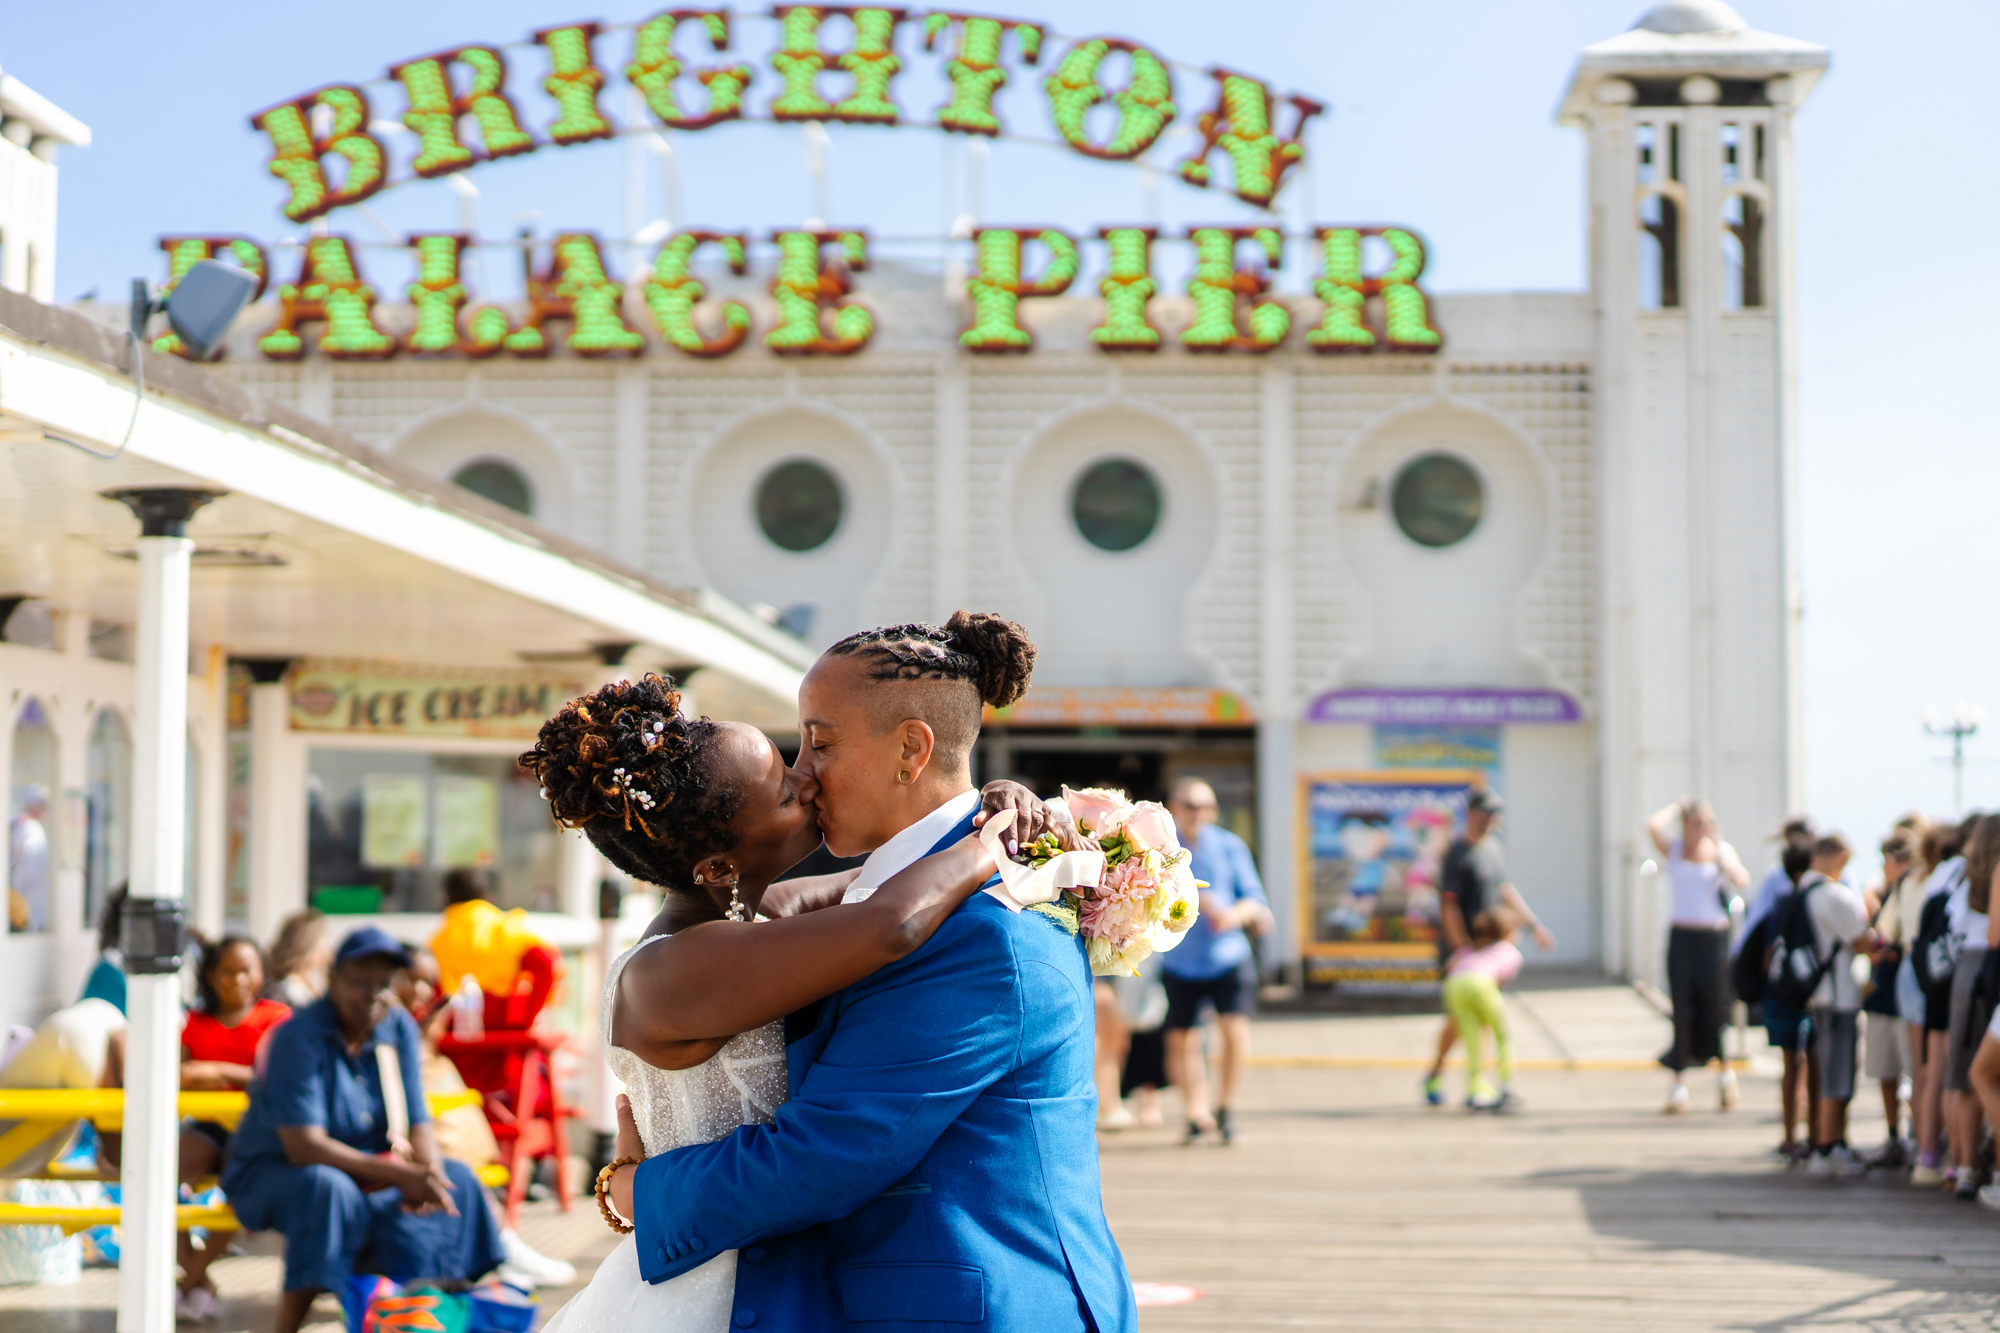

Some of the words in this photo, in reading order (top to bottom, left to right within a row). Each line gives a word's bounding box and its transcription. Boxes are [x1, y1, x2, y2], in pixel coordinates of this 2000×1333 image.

[250, 5, 1325, 222] BRIGHTON
[960, 226, 1443, 354] PIER
[348, 688, 410, 726] ICE
[423, 684, 551, 722] CREAM
